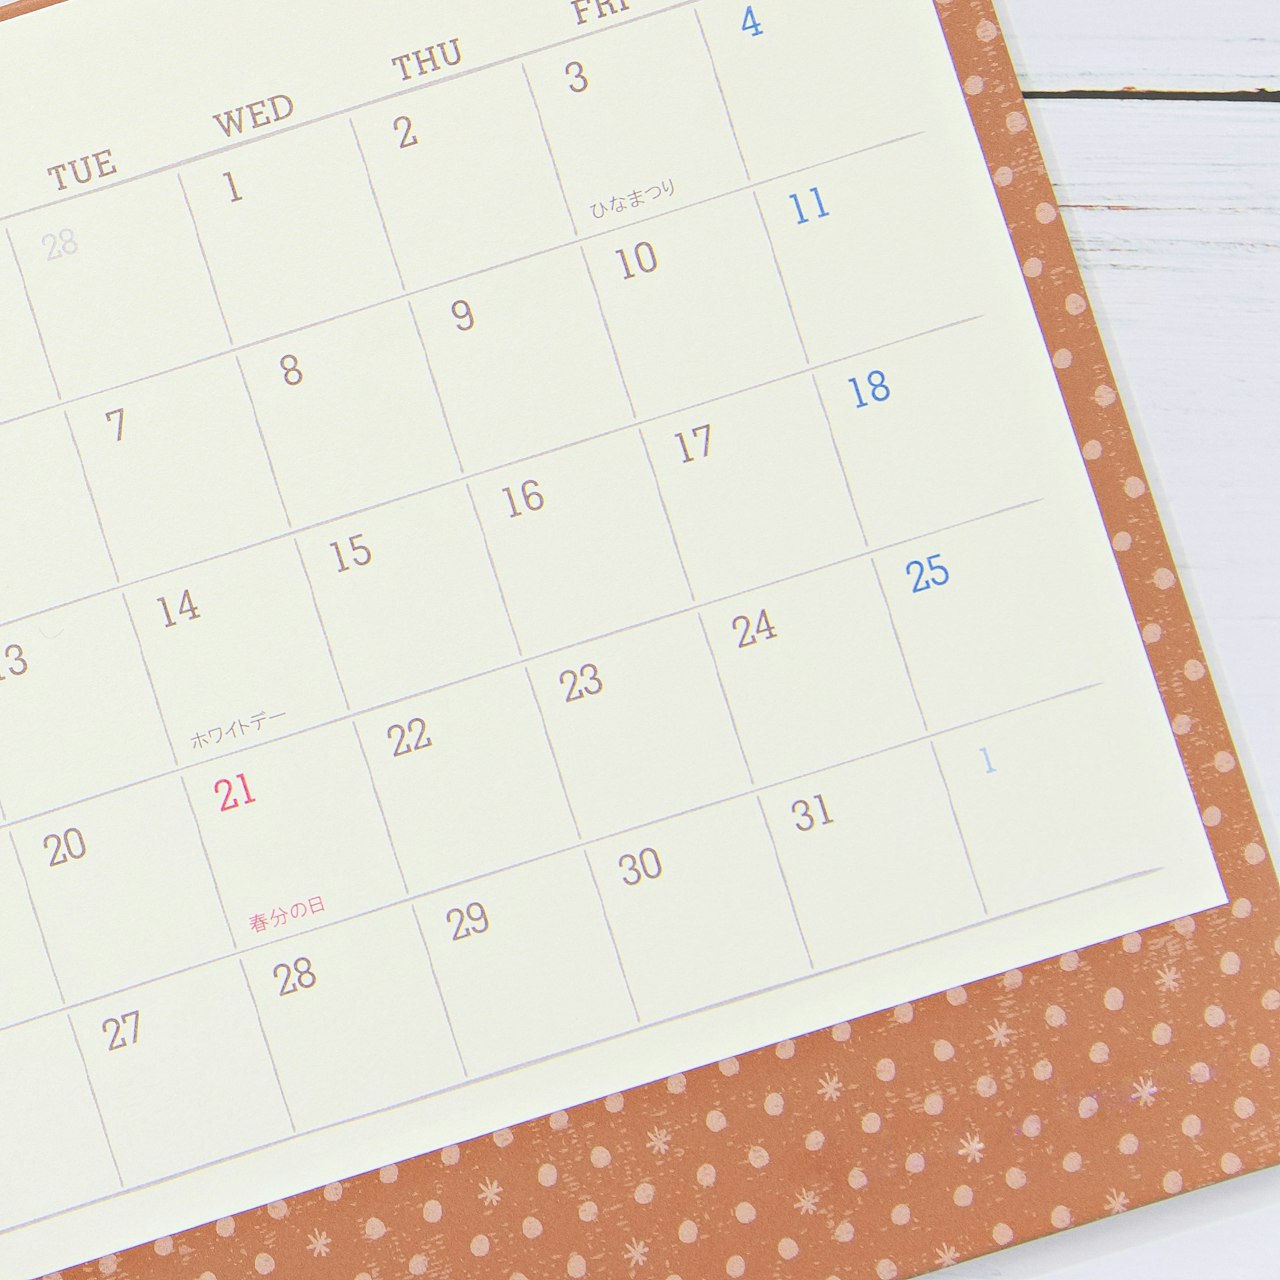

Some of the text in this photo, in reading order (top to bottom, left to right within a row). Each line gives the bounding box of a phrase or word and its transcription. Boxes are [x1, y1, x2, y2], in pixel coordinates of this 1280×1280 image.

[41, 228, 79, 261] 28
[222, 171, 244, 203] 1
[392, 115, 420, 150] 2
[564, 60, 589, 93] 3
[740, 4, 765, 39] 4
[45, 148, 119, 192] TUE
[211, 94, 296, 138] WED
[390, 37, 465, 82] THU
[589, 178, 676, 219] ひなまつり
[104, 407, 126, 442] 7
[279, 353, 305, 386] 8
[450, 299, 476, 332] 9
[614, 241, 660, 281] 10
[788, 185, 830, 225] 11
[156, 588, 202, 629] 14
[329, 533, 373, 573] 15
[501, 479, 545, 519] 16
[673, 423, 713, 464] 17
[847, 368, 891, 410] 18
[42, 827, 89, 868] 20
[213, 772, 257, 813] 21
[386, 717, 433, 758] 22
[558, 663, 605, 704] 23
[731, 608, 781, 649] 24
[904, 552, 950, 594] 25
[190, 710, 287, 749] ホワイトデー
[101, 1009, 140, 1052] 27
[272, 956, 318, 998] 28
[445, 901, 491, 942] 29
[618, 847, 665, 886] 30
[791, 792, 835, 833] 31
[979, 747, 997, 774] 1
[248, 895, 325, 934] 春分の日
